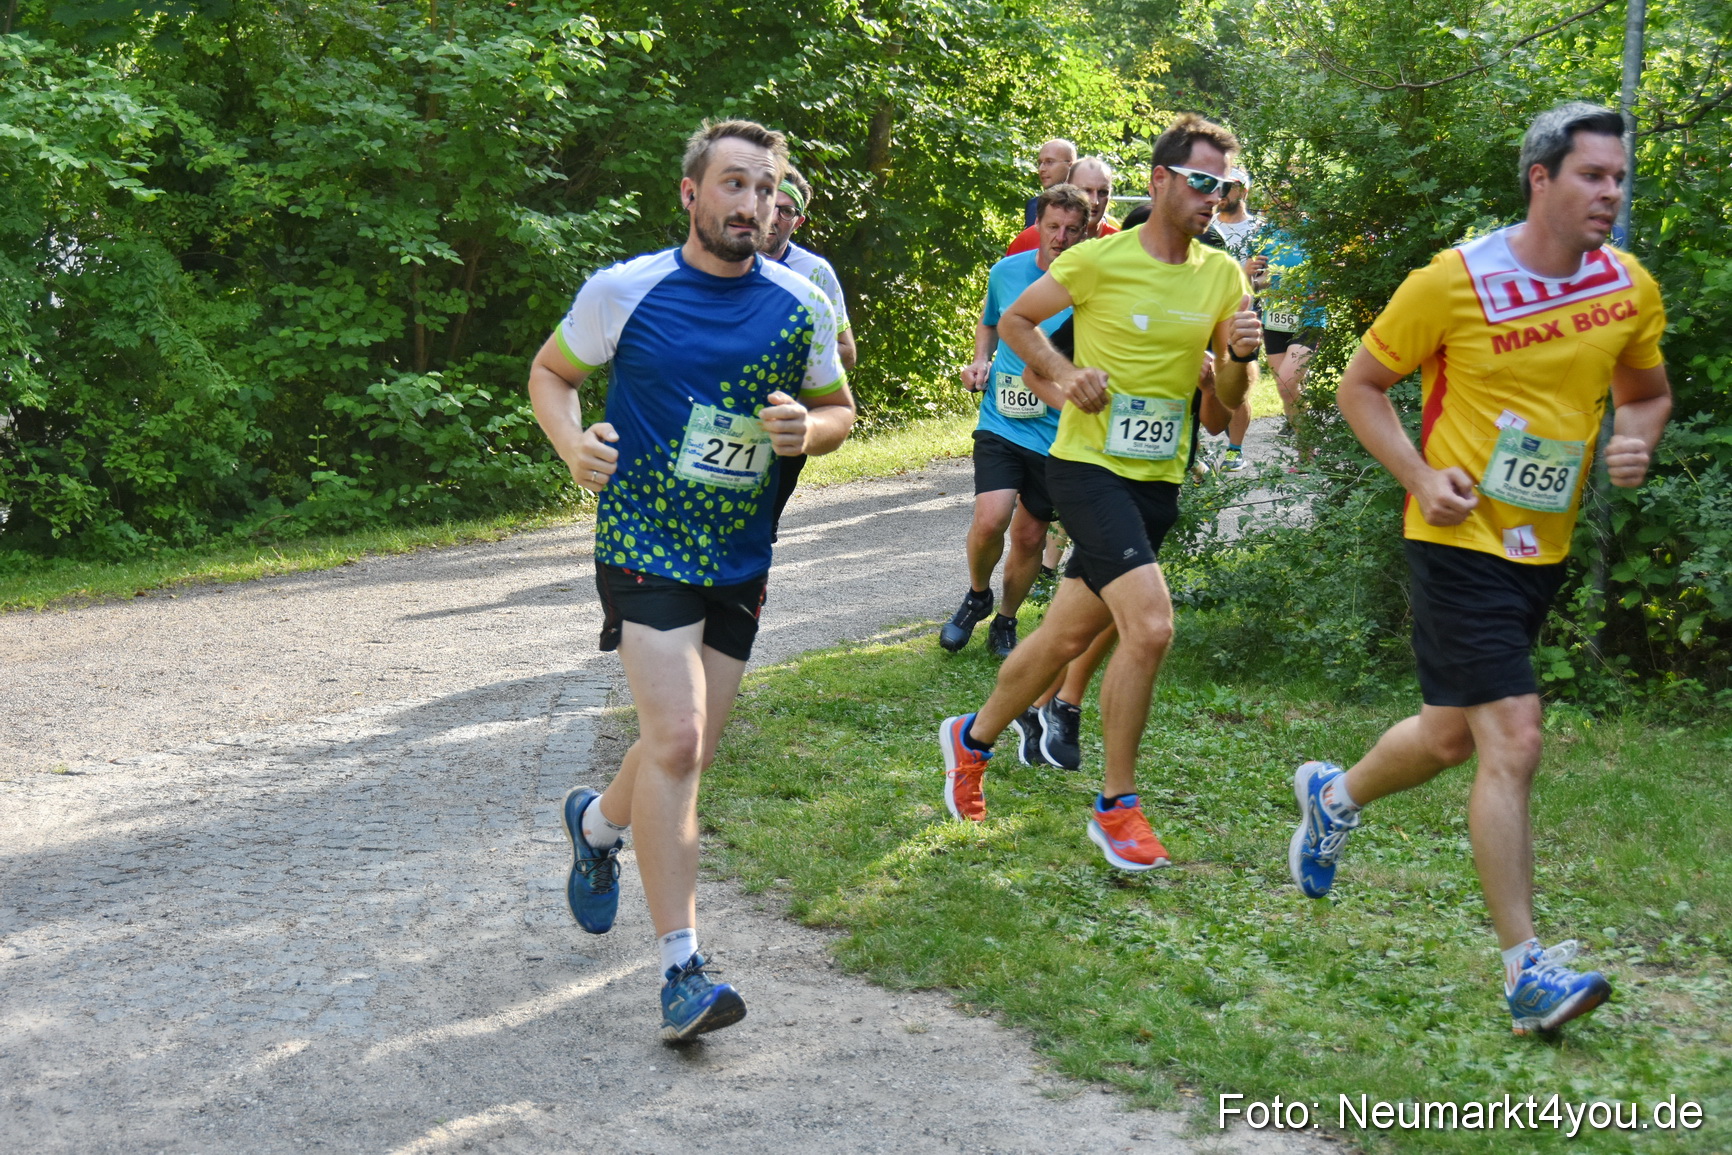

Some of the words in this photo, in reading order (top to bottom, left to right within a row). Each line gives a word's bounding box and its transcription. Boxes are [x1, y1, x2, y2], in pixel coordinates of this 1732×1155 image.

[1269, 312, 1294, 325] 1856
[1490, 319, 1566, 355] MAX
[1001, 389, 1038, 406] 1860
[1120, 418, 1174, 443] 1293
[702, 438, 757, 469] 271
[1504, 457, 1569, 493] 1658
